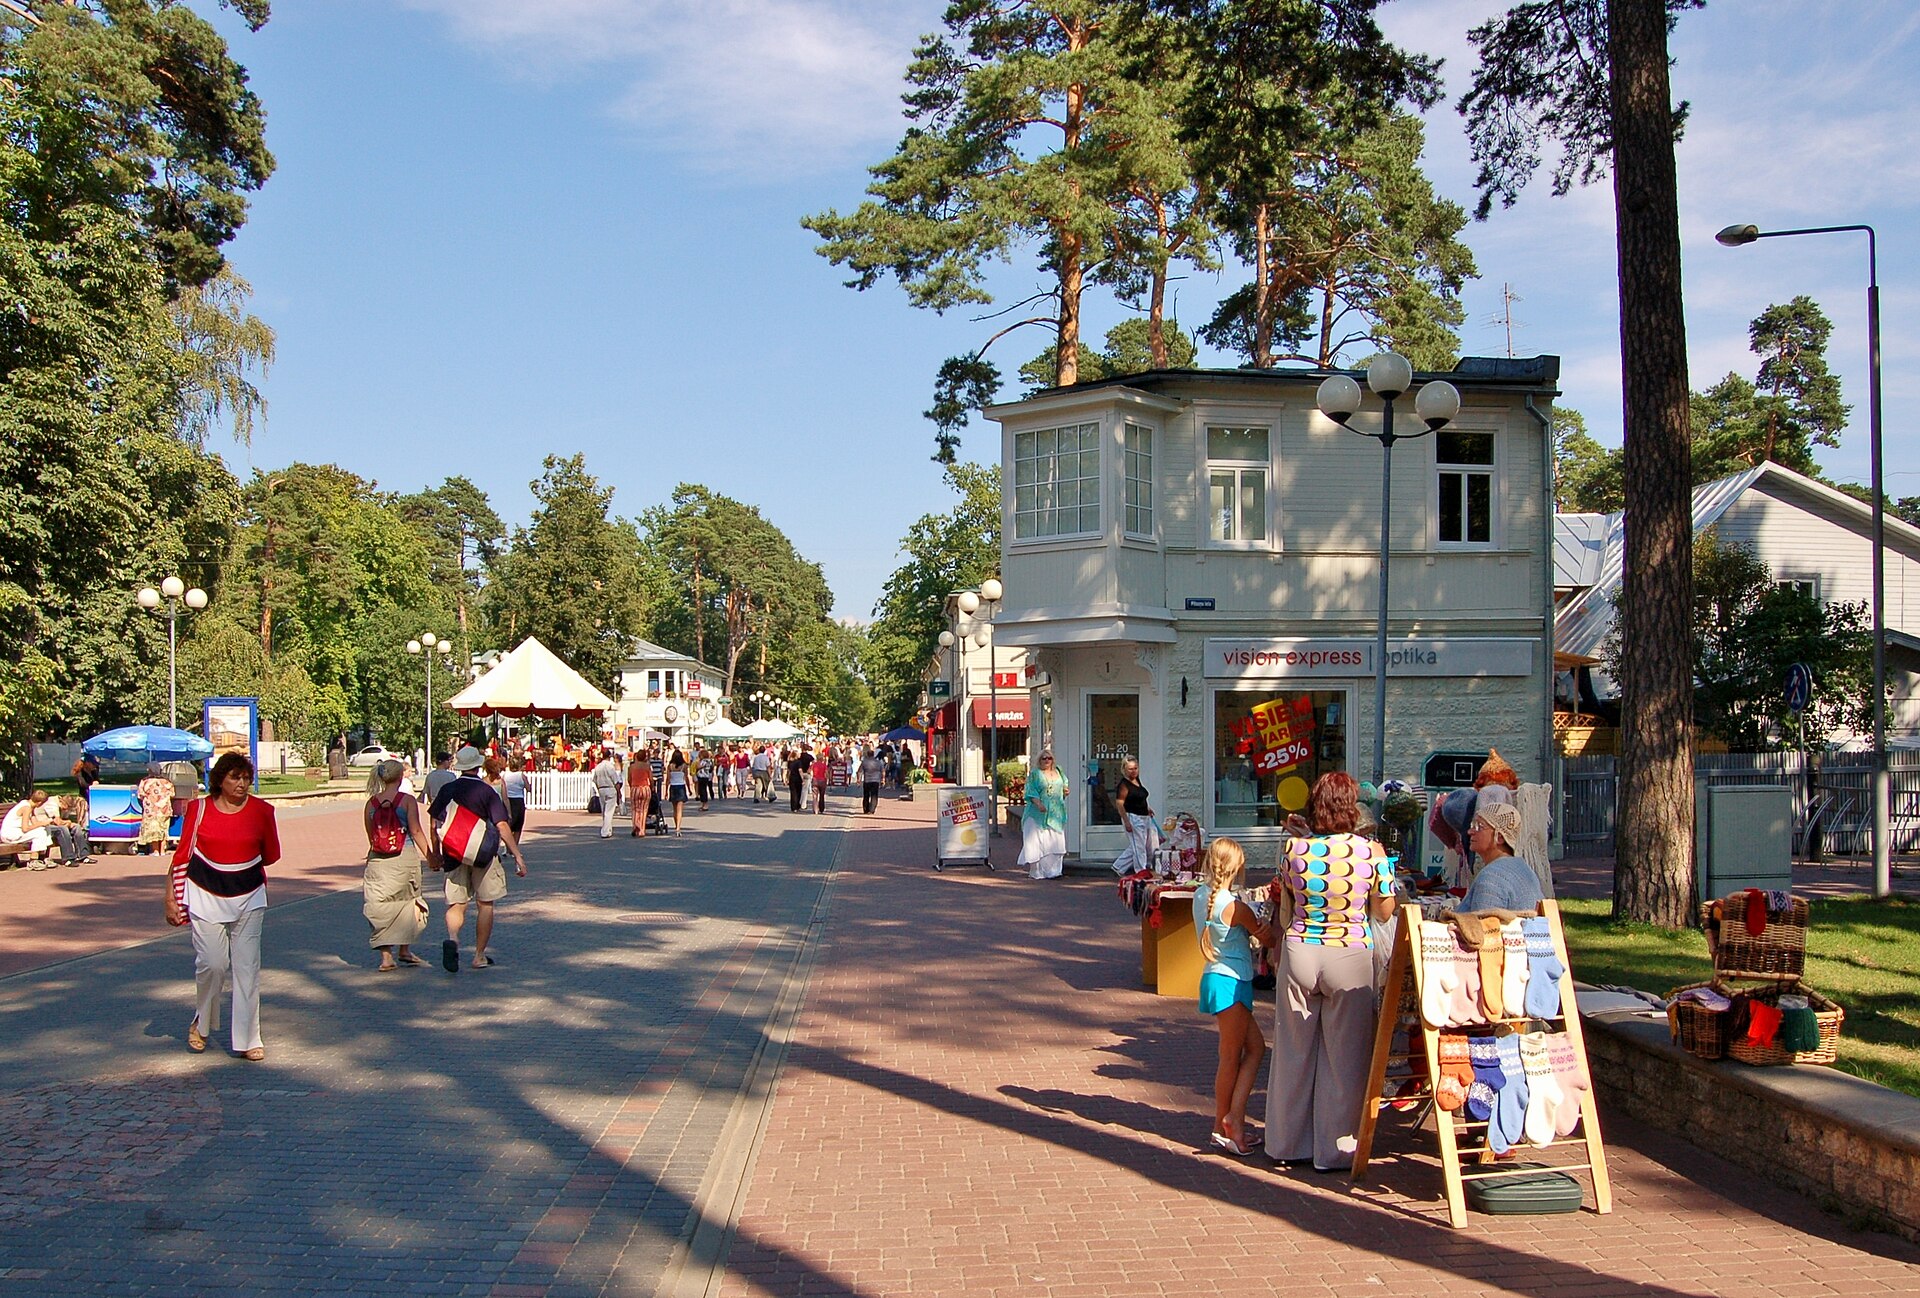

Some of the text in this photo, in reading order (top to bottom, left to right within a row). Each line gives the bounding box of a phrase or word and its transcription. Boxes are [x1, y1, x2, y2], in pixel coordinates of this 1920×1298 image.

[1223, 648, 1278, 666] vision
[1285, 651, 1362, 668] express
[1227, 695, 1312, 737] VISIEM
[1096, 743, 1108, 753] 10
[1116, 743, 1129, 753] 20
[1257, 741, 1308, 769] -25%
[946, 796, 974, 808] VISIEM
[954, 813, 976, 823] -25%
